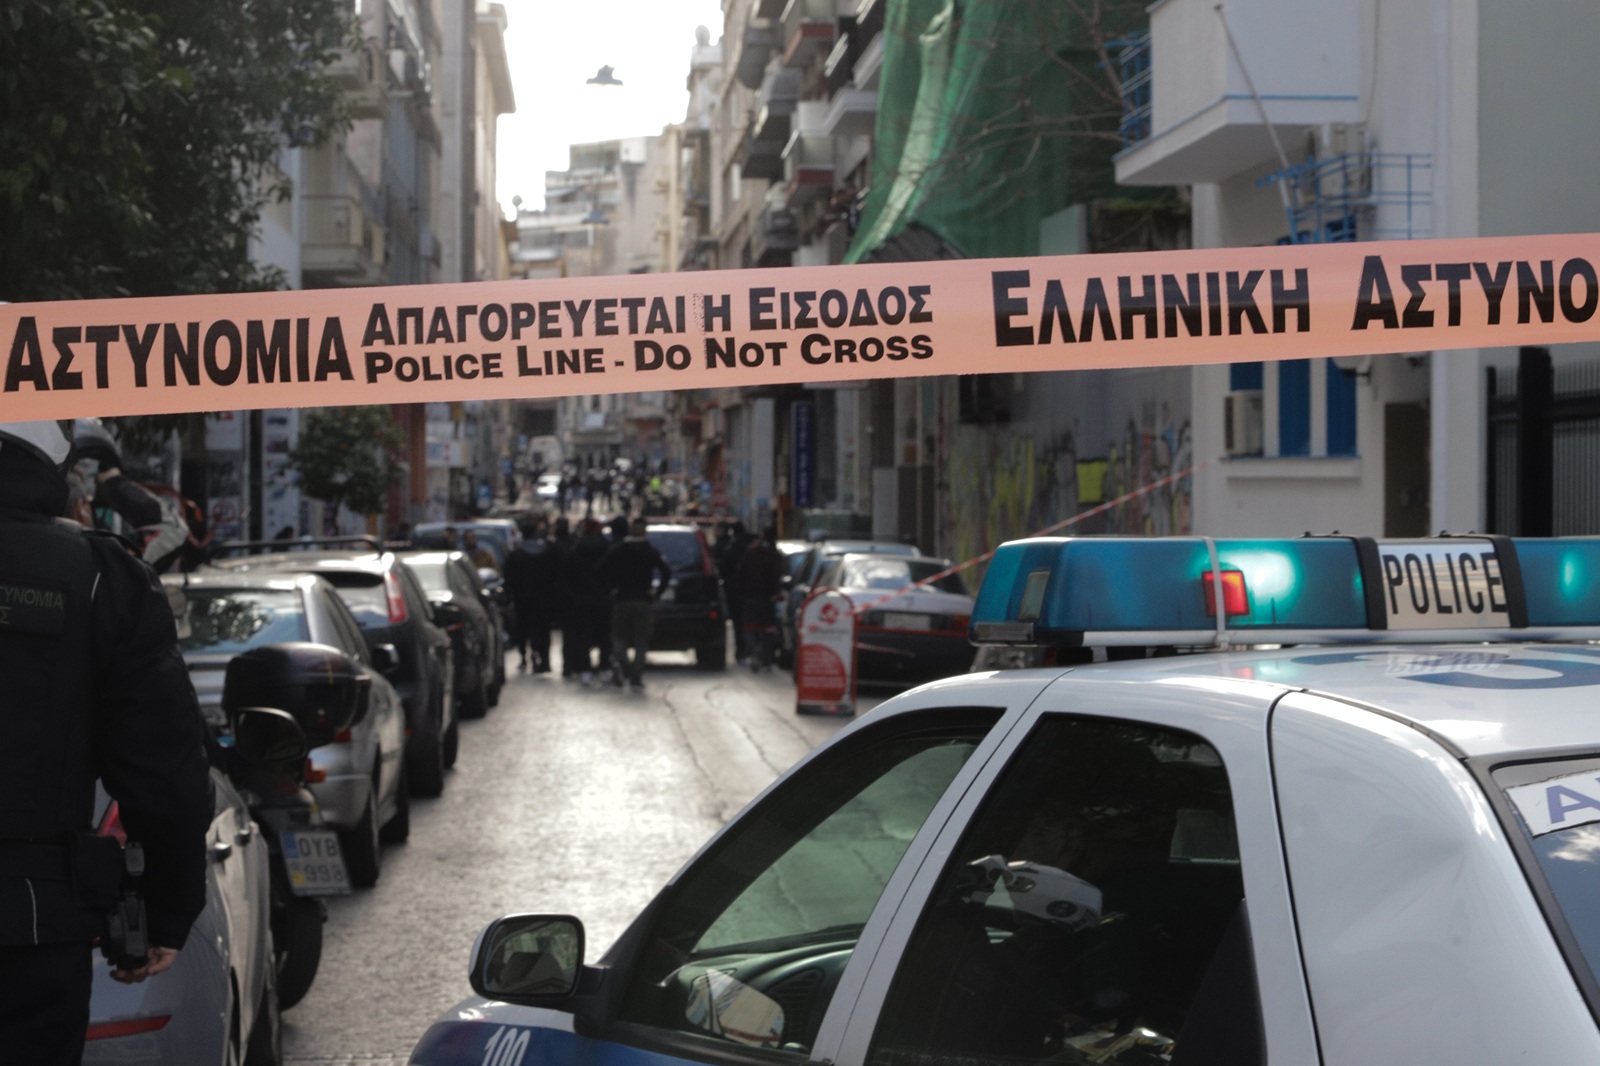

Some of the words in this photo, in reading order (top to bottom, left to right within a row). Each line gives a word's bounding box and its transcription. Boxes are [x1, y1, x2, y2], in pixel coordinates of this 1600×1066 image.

[361, 296, 688, 347] ΑΠΑΓΟΡΕΥΕΤΑΙ
[748, 285, 934, 331] ΕΙΣΟΔΟΣ
[991, 268, 1311, 347] ΕΛΛΗΝΙΚΗ
[4, 316, 355, 392] ΑΣΤΥΝΟΜΙΑ
[364, 352, 503, 384] POLICE
[517, 345, 605, 377] LINE
[634, 340, 692, 372] DO
[705, 337, 788, 369] NOT
[800, 333, 934, 365] CROSS
[0, 586, 63, 610] ΥΝΟΜΙΑ
[1382, 551, 1508, 615] POLICE
[482, 1025, 531, 1066] 100
